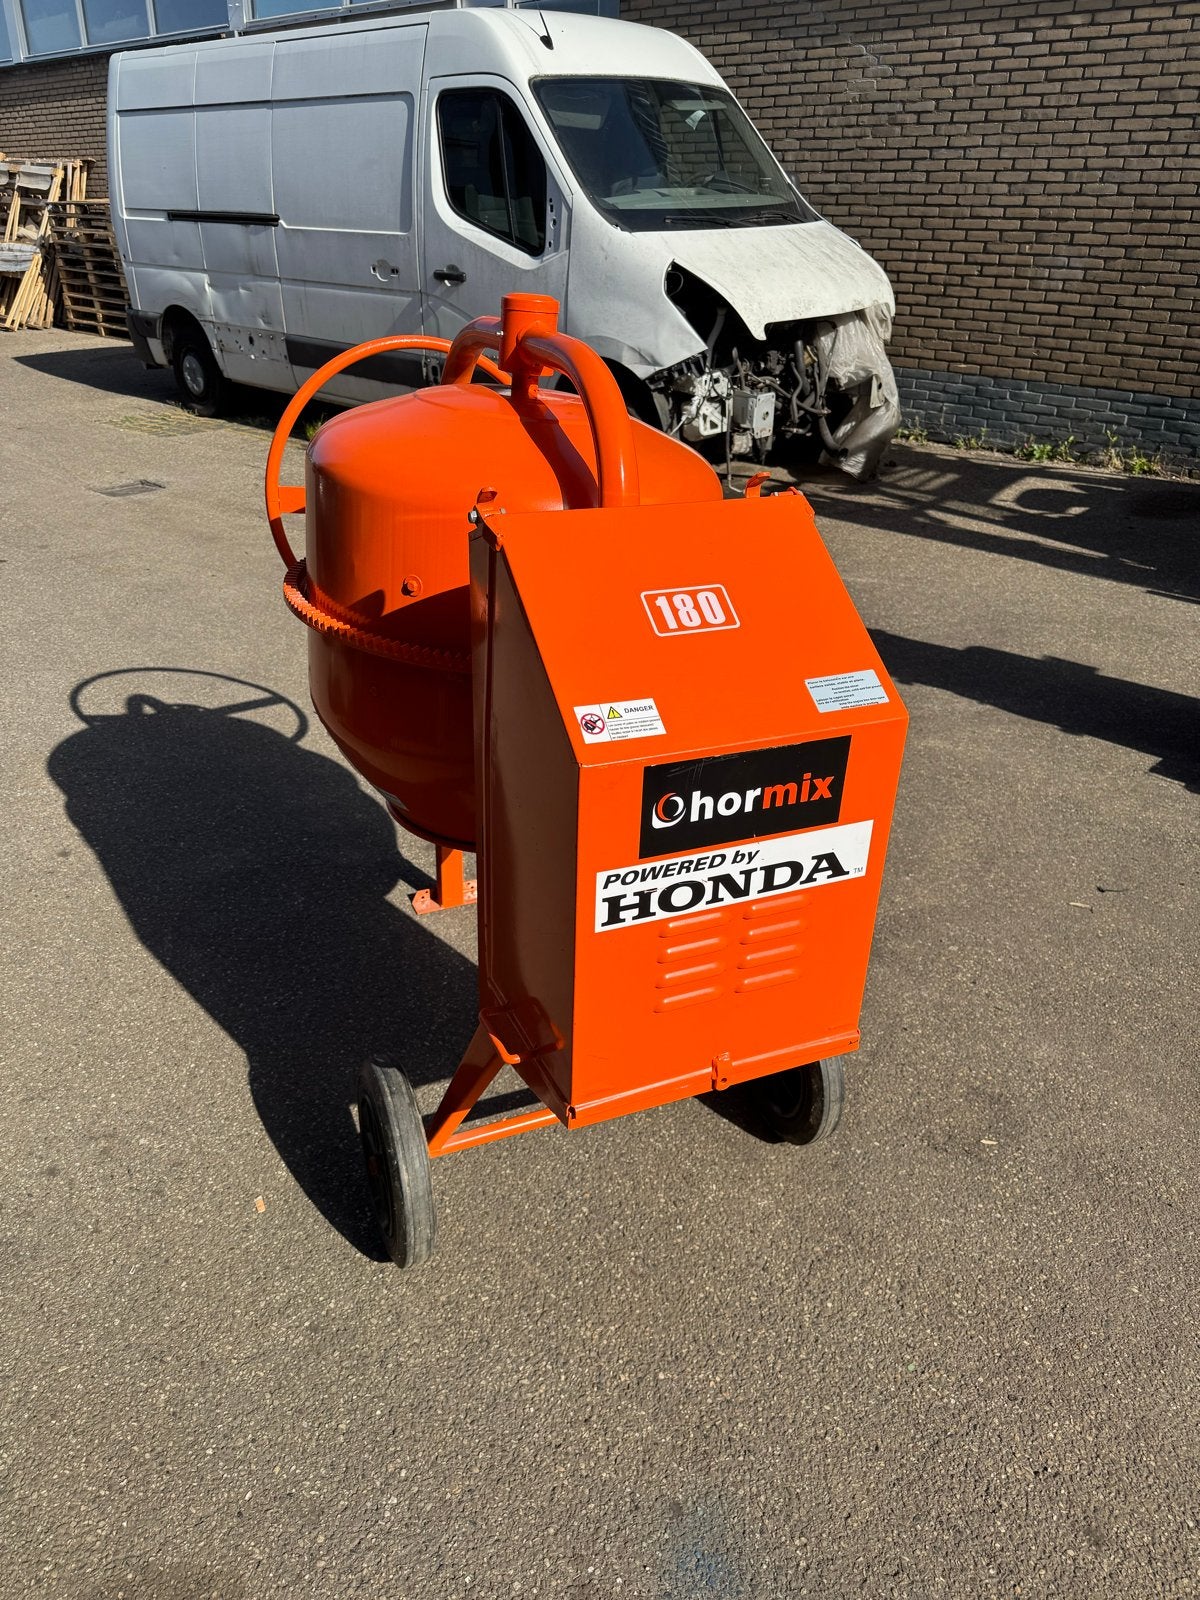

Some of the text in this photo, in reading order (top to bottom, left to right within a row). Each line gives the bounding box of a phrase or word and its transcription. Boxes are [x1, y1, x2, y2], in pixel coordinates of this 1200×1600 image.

[655, 590, 727, 630] 180
[624, 704, 654, 714] DANGER
[689, 773, 835, 822] hormix
[600, 852, 850, 928] HONDA
[602, 848, 760, 890] POWERED by
